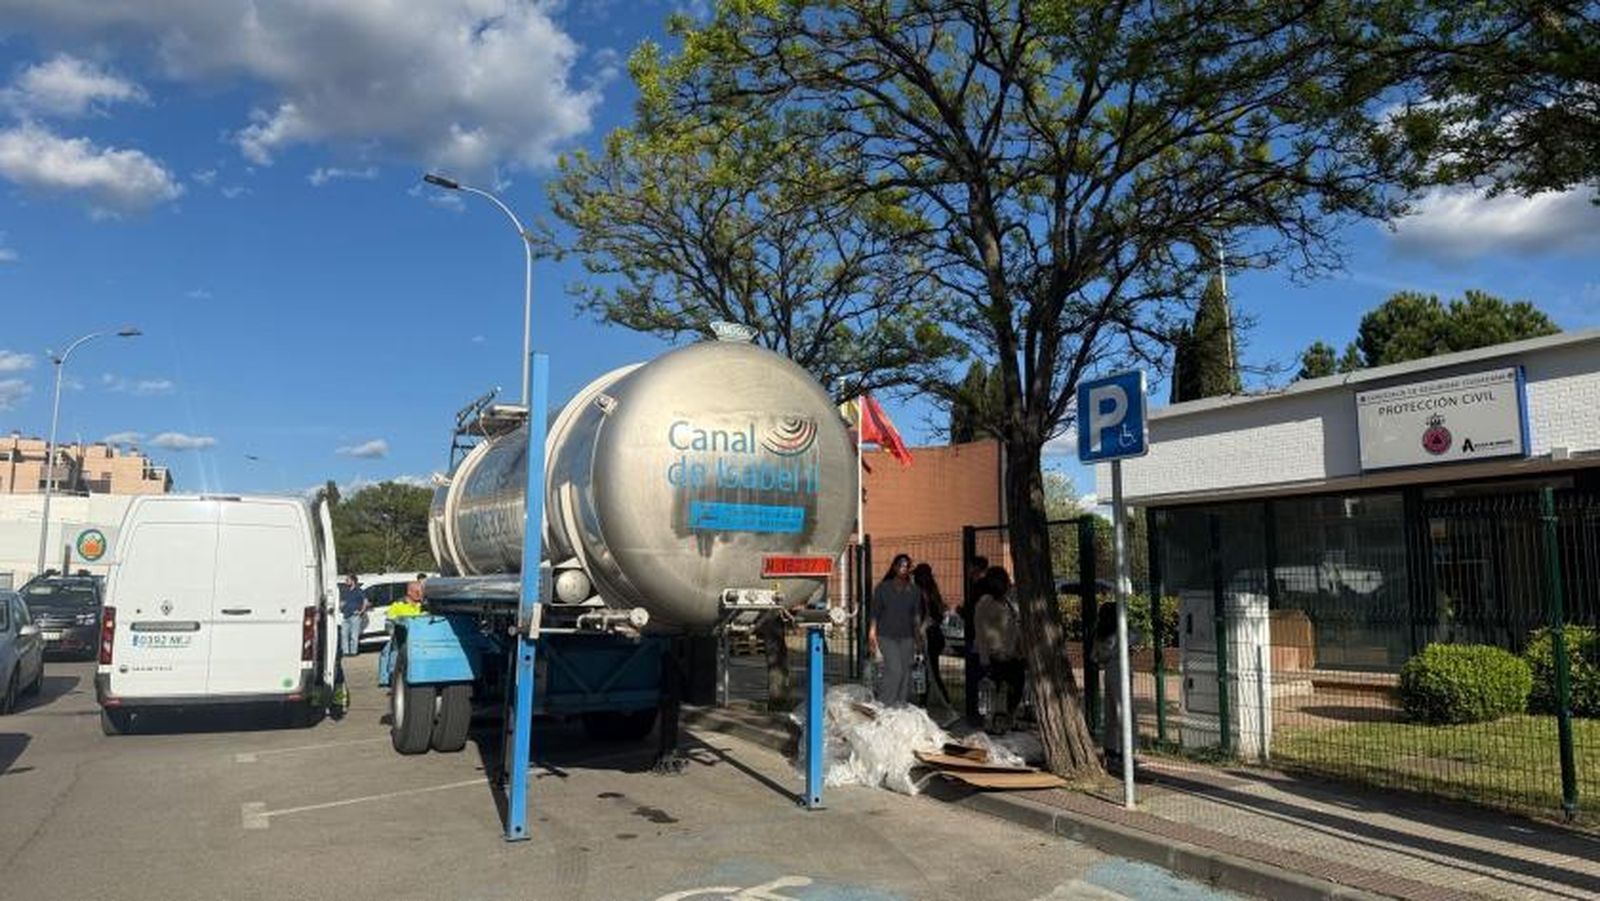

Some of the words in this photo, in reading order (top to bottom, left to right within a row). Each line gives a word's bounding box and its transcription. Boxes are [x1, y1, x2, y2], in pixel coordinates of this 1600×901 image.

[1089, 385, 1128, 452] P
[1378, 396, 1458, 416] PROTECCIÓN
[1462, 390, 1497, 405] CIVIL
[668, 420, 755, 453] Canal
[668, 456, 707, 489] de
[717, 457, 799, 492] Isabel
